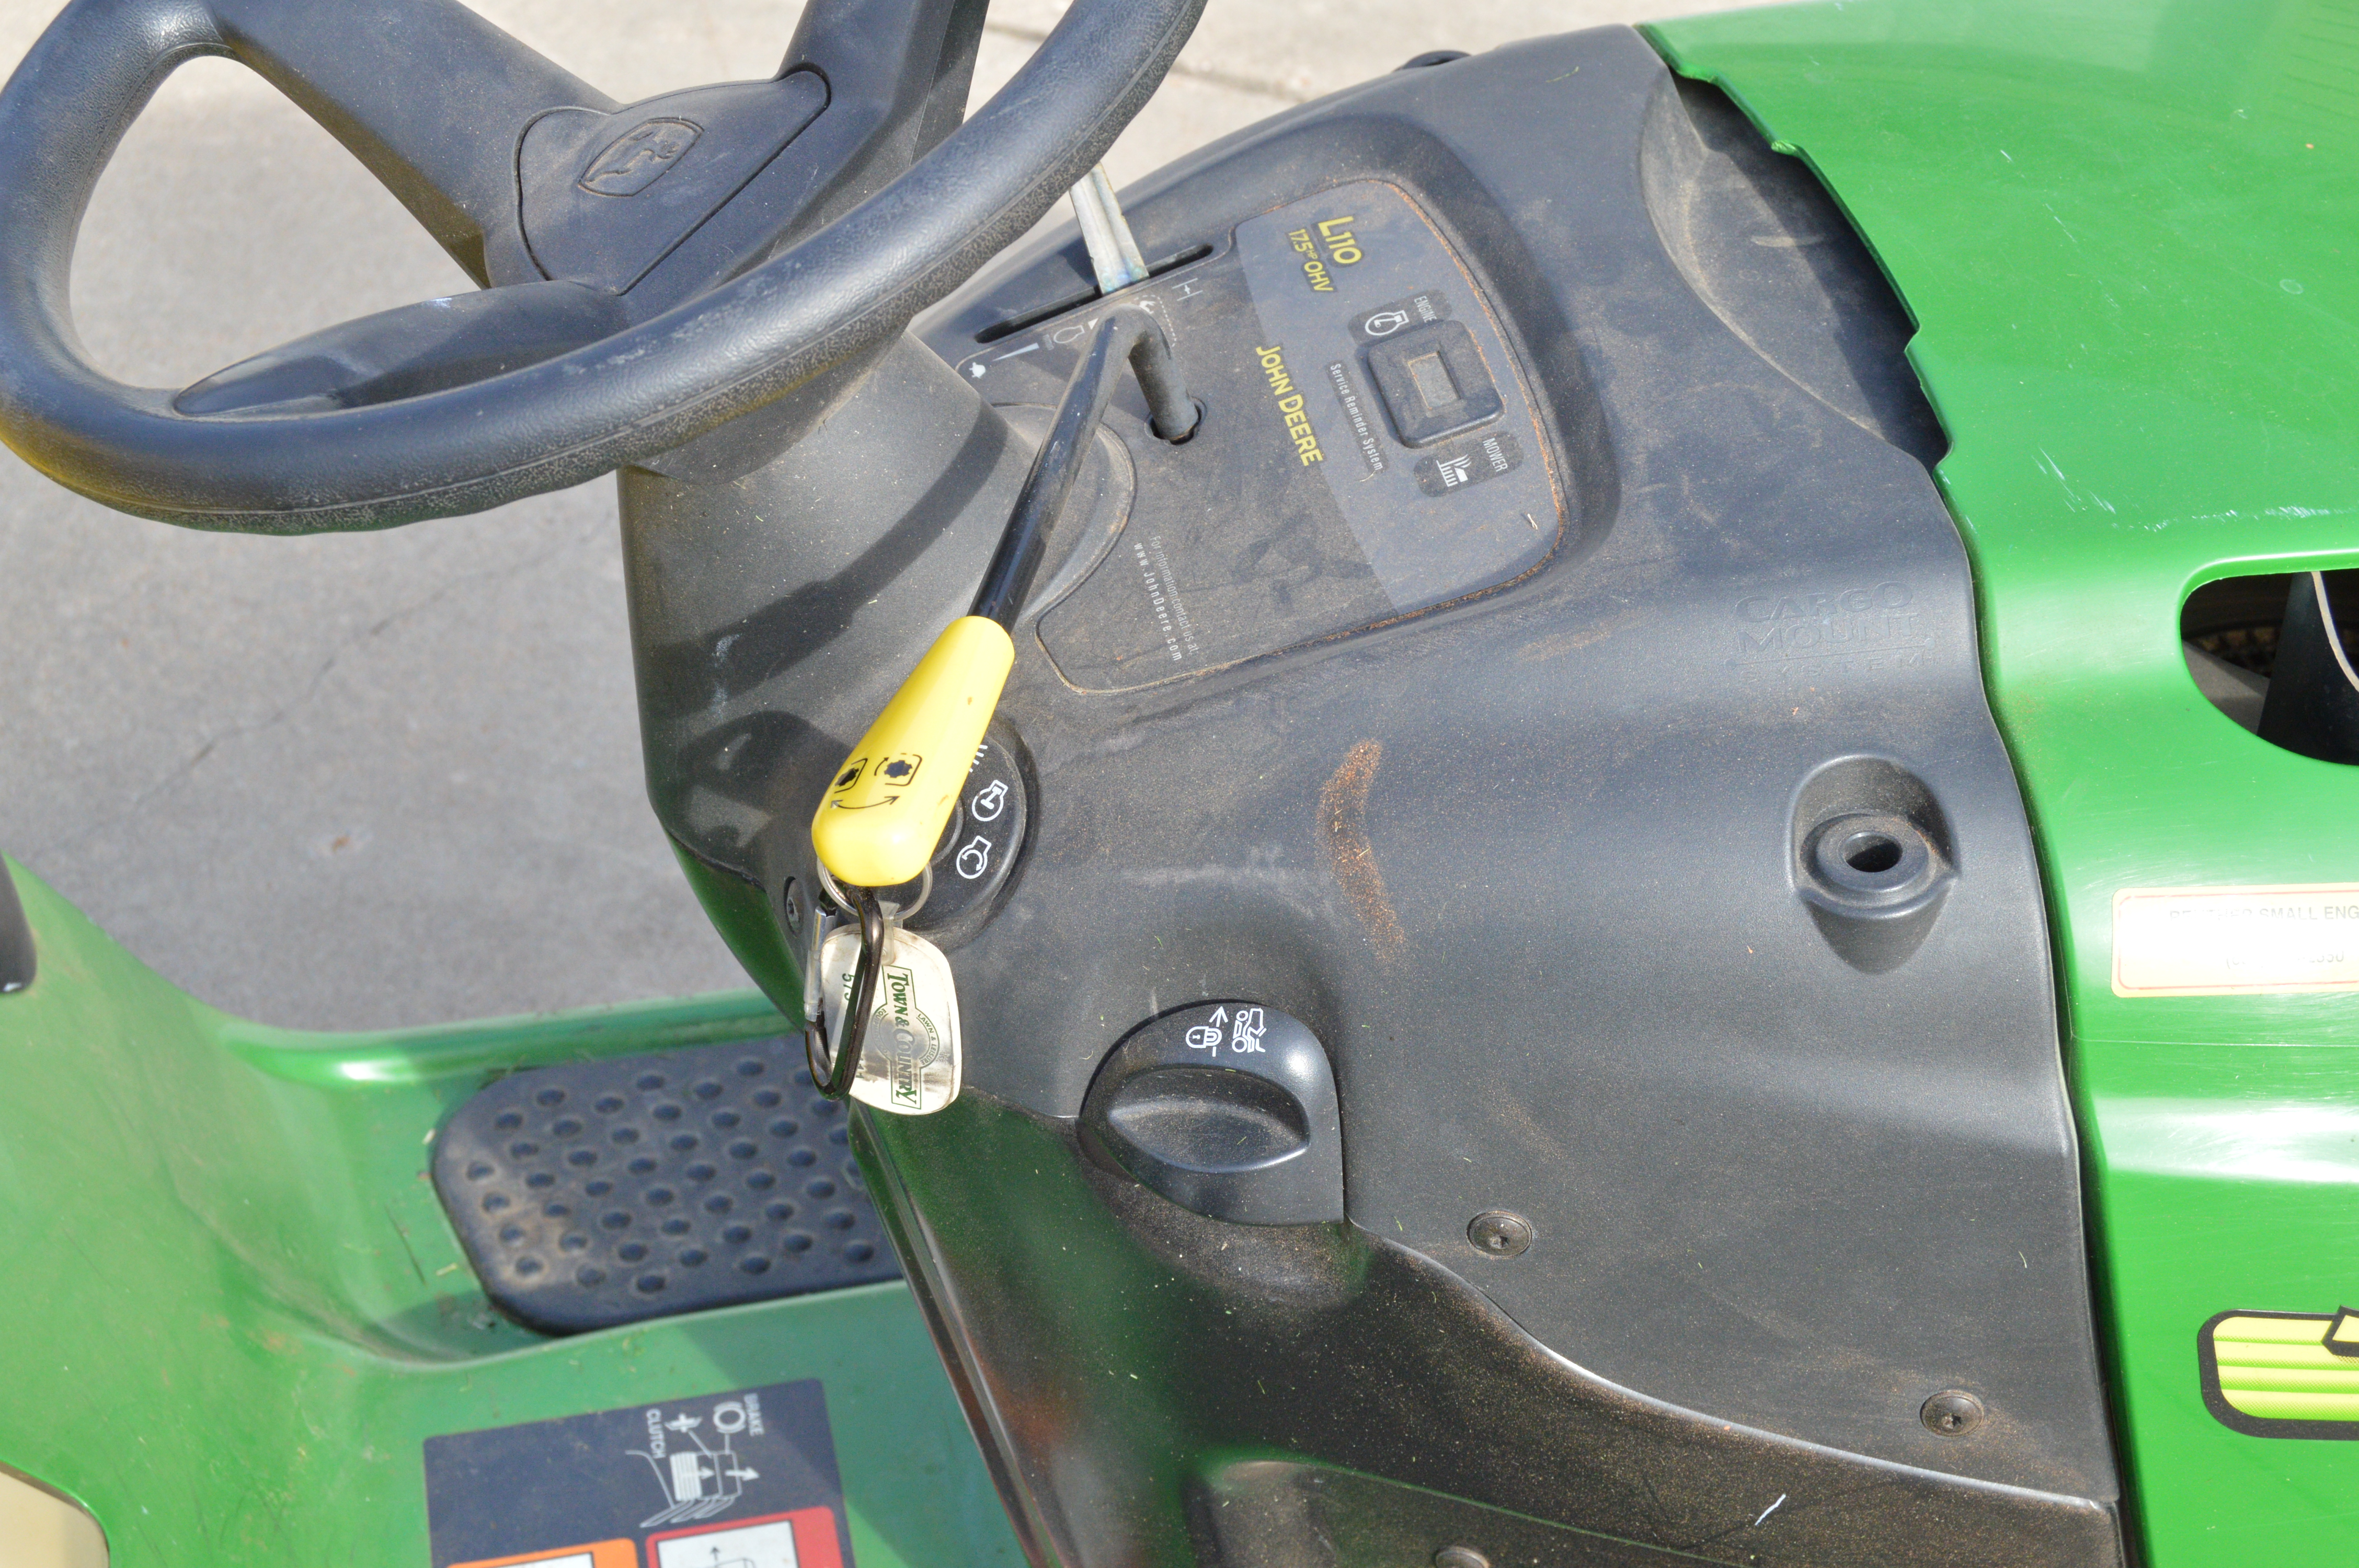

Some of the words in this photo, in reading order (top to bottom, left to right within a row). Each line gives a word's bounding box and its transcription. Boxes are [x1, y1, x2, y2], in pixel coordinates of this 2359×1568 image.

[1318, 216, 1362, 264] L110
[1304, 261, 1334, 292] OHV
[1414, 295, 1437, 323] ENGINE
[1256, 346, 1293, 396] JOHN
[1278, 394, 1323, 466] DEERE
[1331, 364, 1350, 395] Service
[1344, 396, 1368, 436] Reminder
[1363, 438, 1383, 471] System
[1483, 438, 1508, 472] MOWER
[1150, 536, 1161, 549] For
[1155, 551, 1178, 597] information
[1134, 543, 1182, 661] www.JohnDeere.com
[1172, 598, 1191, 629] contact
[1735, 581, 1913, 622] CARGO
[1183, 631, 1194, 642] us
[1736, 613, 1919, 653] MOUNT
[2259, 906, 2318, 920] SMALL
[895, 1017, 910, 1028] &
[918, 1013, 934, 1033] LAWN
[892, 1028, 917, 1104] COUNTRY
[920, 1043, 937, 1065] LEISURE
[646, 1409, 667, 1459] CLUTCH
